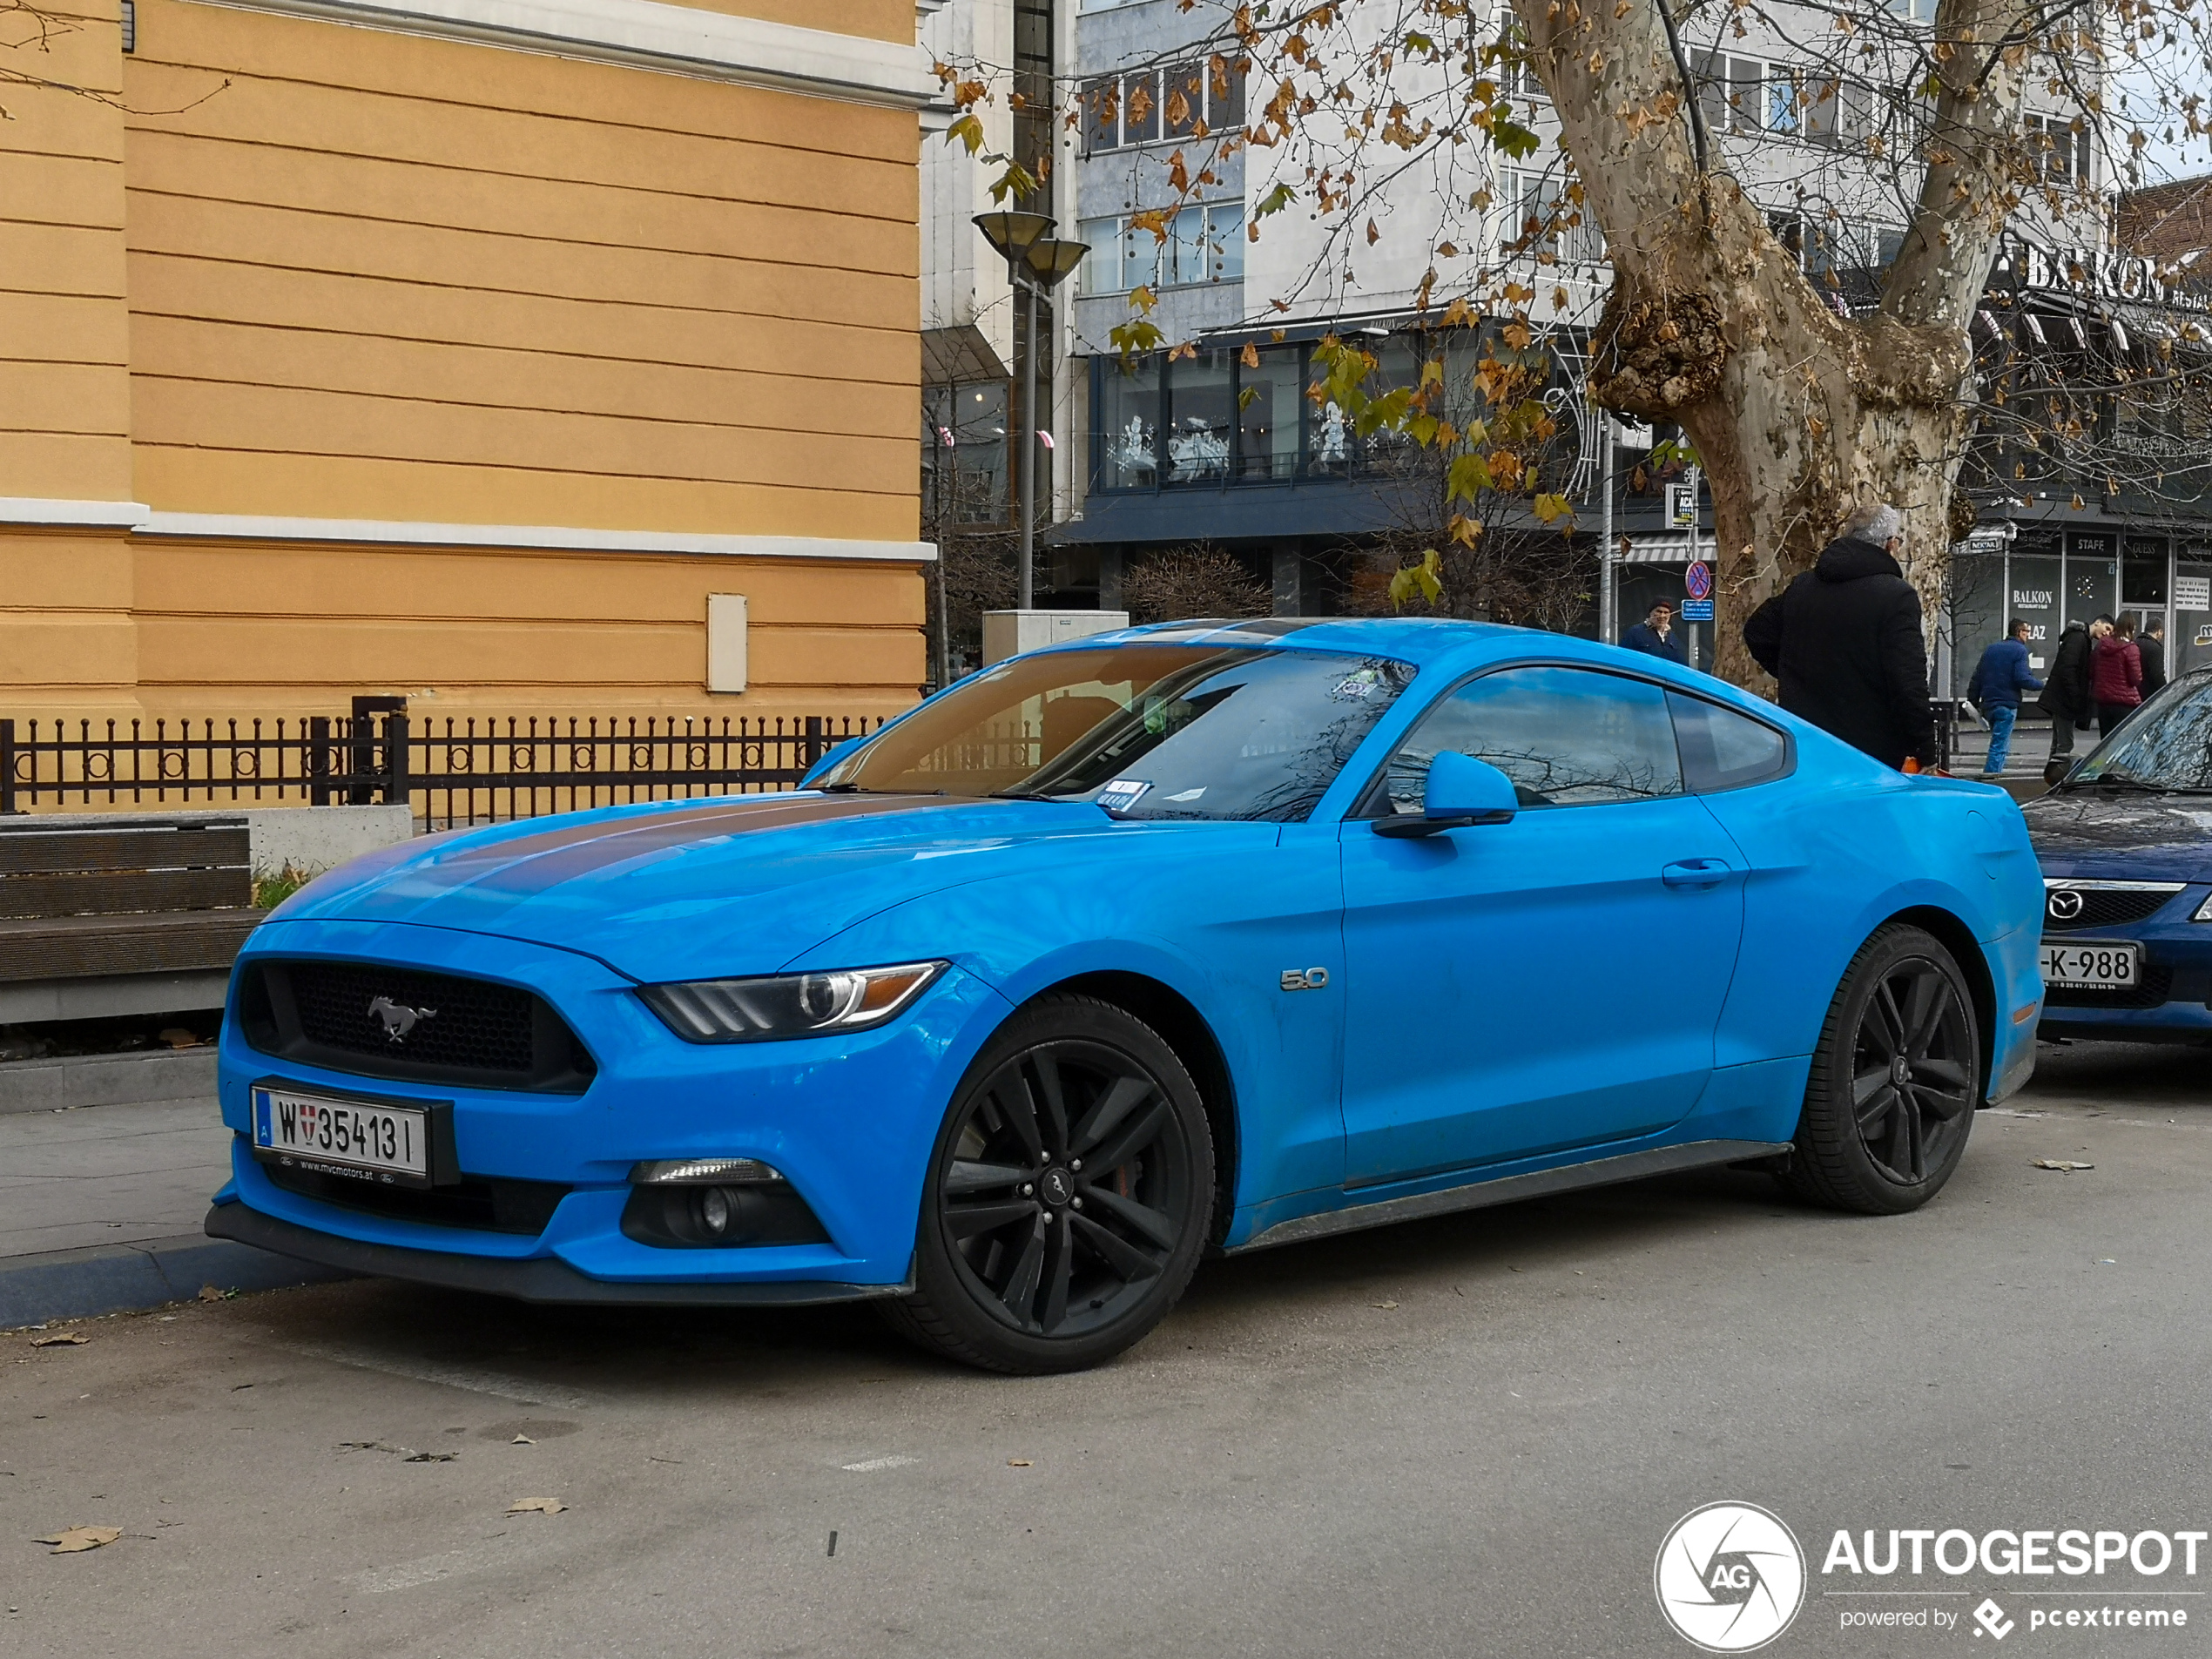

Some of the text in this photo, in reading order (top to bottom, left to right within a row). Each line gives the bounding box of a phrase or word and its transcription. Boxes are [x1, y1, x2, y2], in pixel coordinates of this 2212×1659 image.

[2013, 590, 2053, 604] BALKON
[1280, 967, 1329, 990] 5.0
[261, 1125, 267, 1138] A
[279, 1101, 296, 1144] W
[300, 1160, 373, 1181] www.mvcmotors.at
